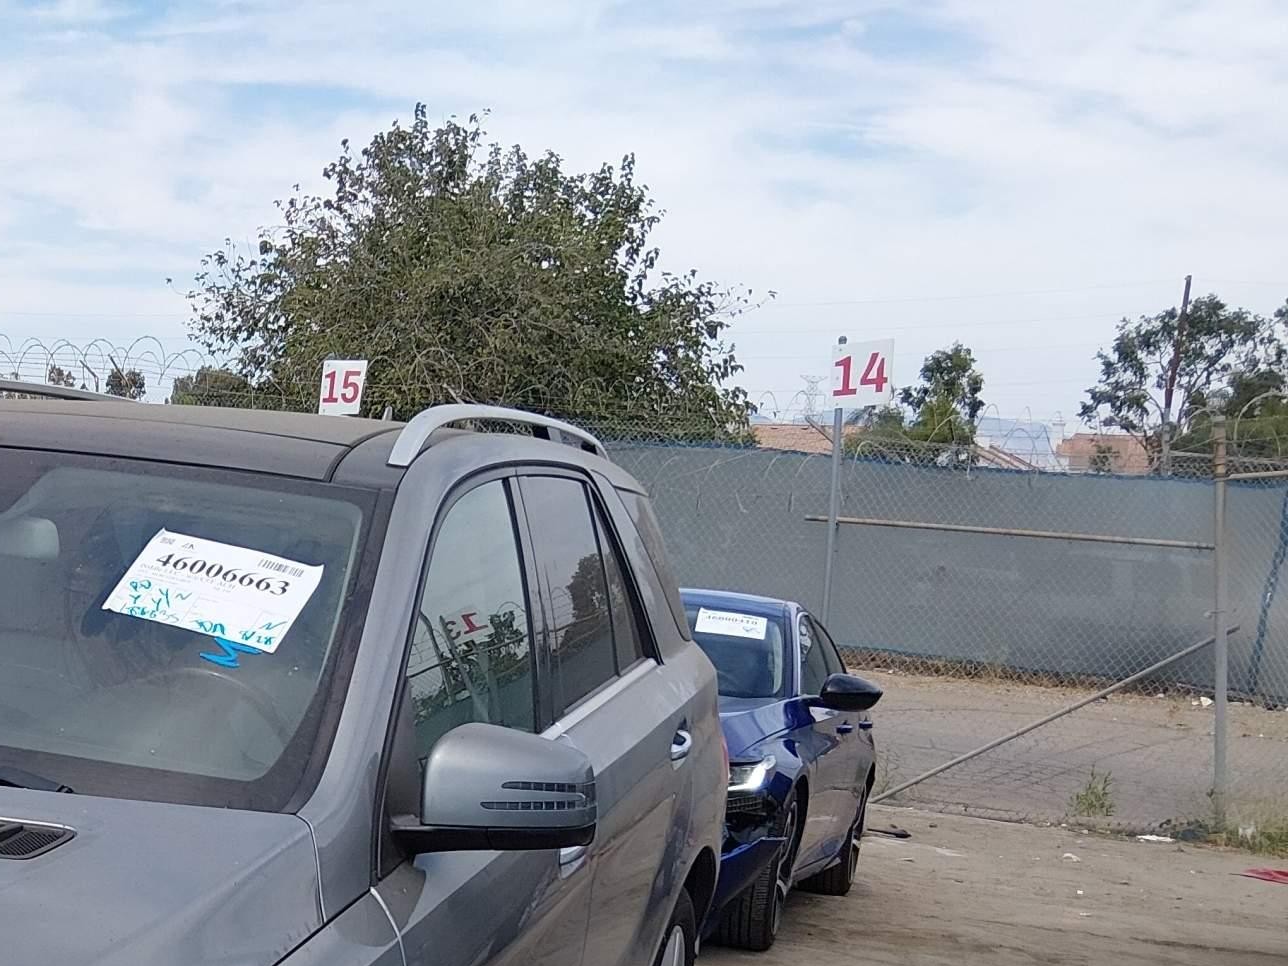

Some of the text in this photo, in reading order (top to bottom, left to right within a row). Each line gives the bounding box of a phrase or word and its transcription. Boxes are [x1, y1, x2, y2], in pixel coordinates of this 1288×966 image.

[322, 370, 362, 404] 15
[832, 352, 888, 396] 14
[156, 552, 291, 597] 46006663
